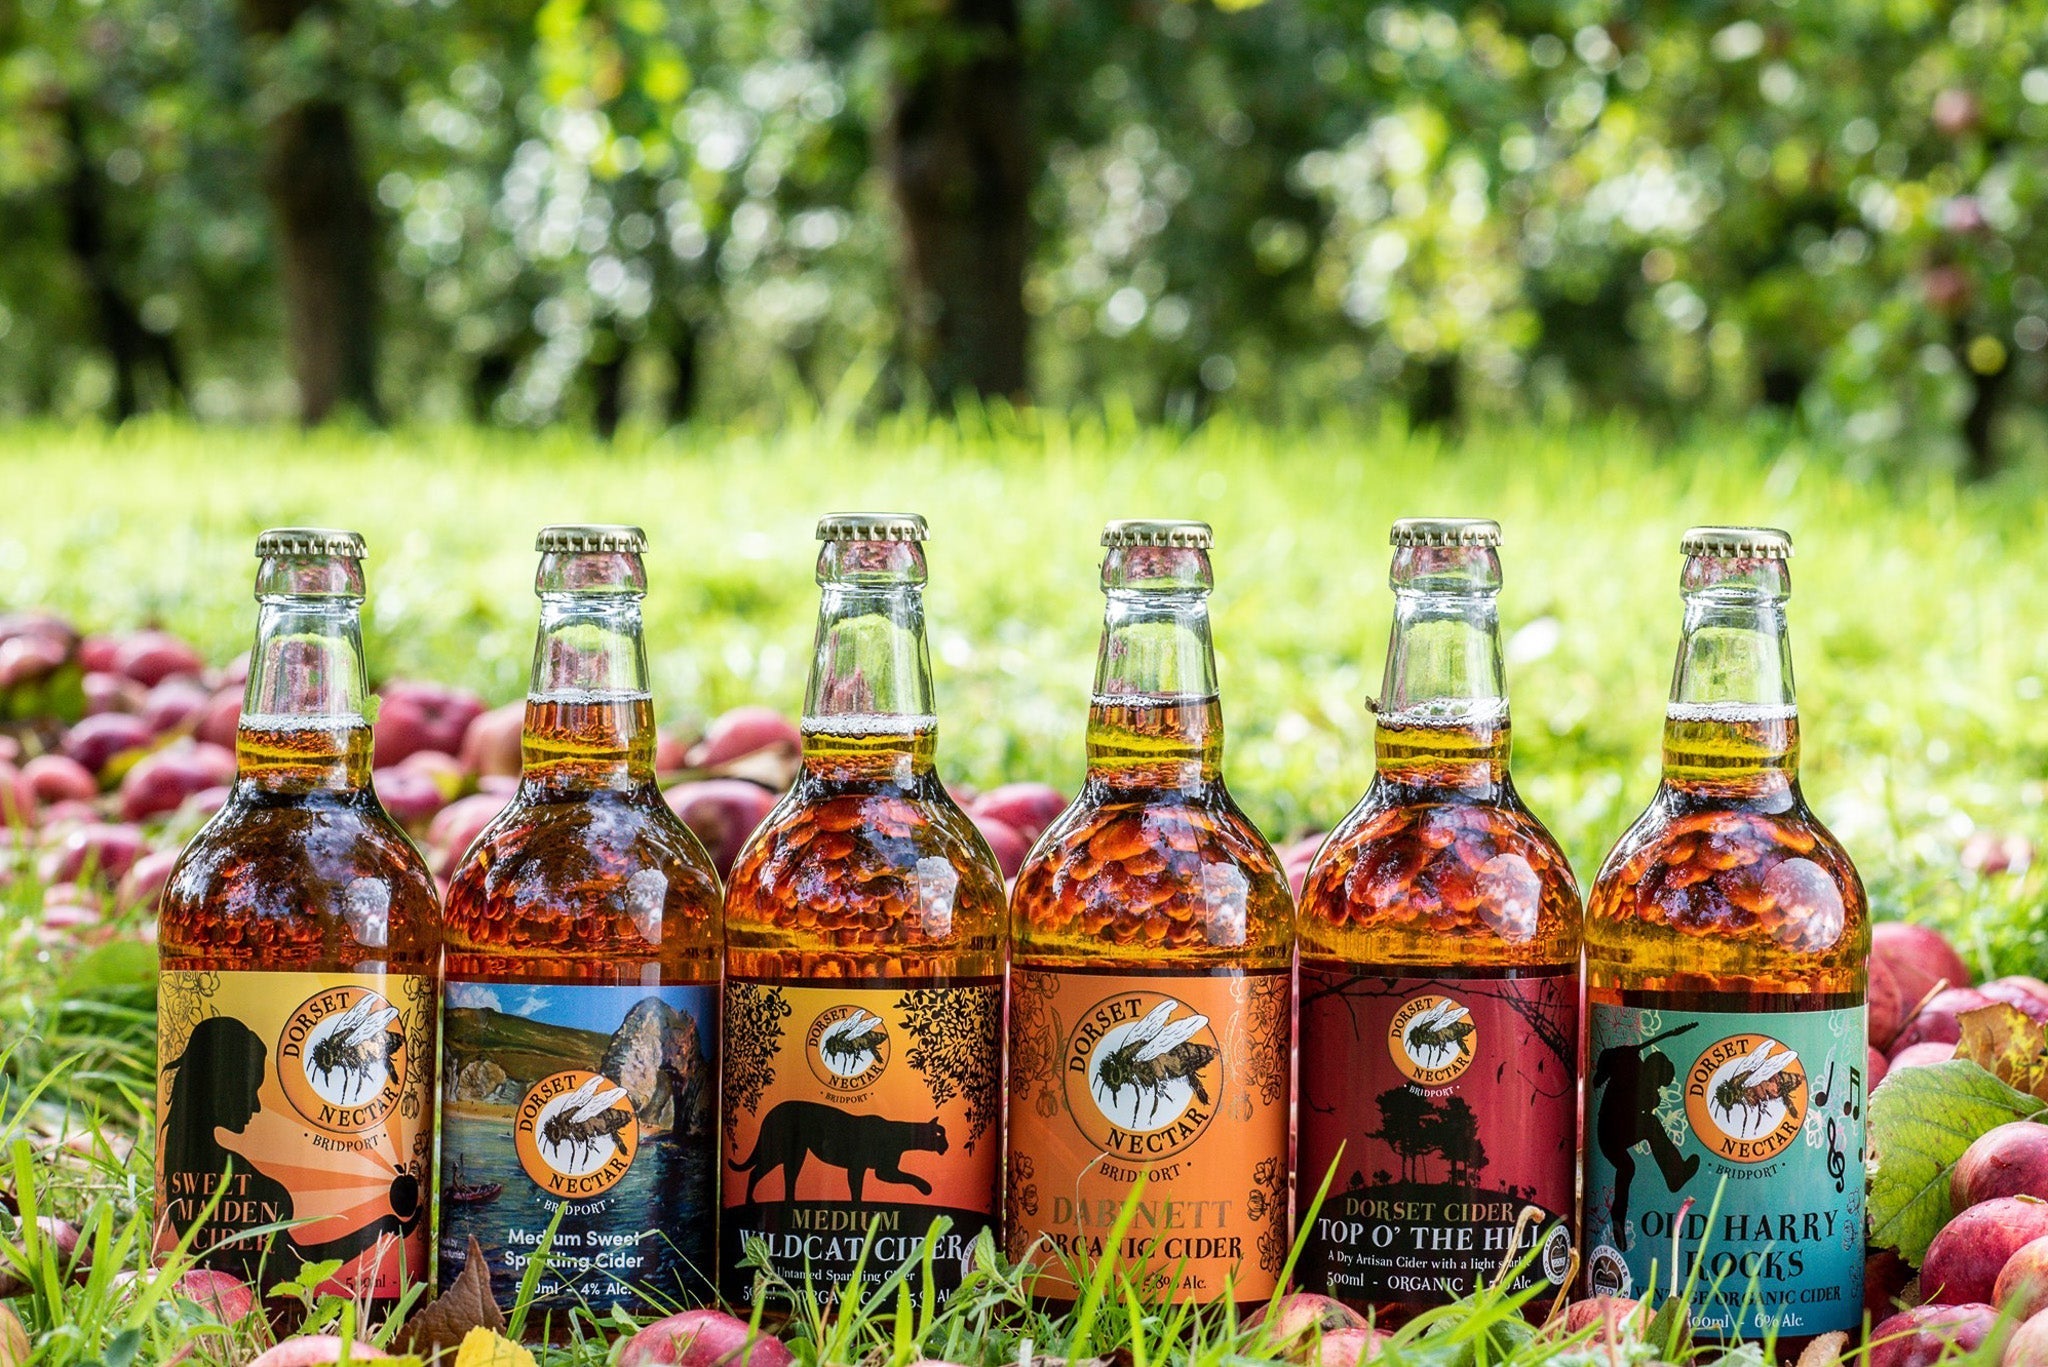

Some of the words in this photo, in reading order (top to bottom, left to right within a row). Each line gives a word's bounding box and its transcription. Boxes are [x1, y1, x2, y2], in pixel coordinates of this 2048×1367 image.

[283, 992, 350, 1059] DORSET
[808, 1008, 848, 1048] DORSET
[1392, 998, 1433, 1039] DORSET
[1069, 998, 1142, 1074] DORSET
[828, 1063, 884, 1089] NECTAR
[1413, 1056, 1469, 1082] NECTAR
[1690, 1039, 1749, 1098] DORSET
[519, 1075, 576, 1133] DORSET
[825, 1092, 868, 1104] BRIDPORT
[1409, 1085, 1453, 1098] BRIDPORT
[318, 1086, 399, 1127] NECTAR
[312, 1133, 379, 1152] BRIDPORT
[1105, 1107, 1209, 1154] NECTAR
[1720, 1121, 1798, 1158] NECTAR
[548, 1158, 628, 1193] NECTAR
[1715, 1164, 1778, 1180] BRIDPORT
[544, 1199, 607, 1216] BRDPORT
[791, 1209, 901, 1232] MEDIUM
[1052, 1196, 1233, 1229] DABNETT
[1346, 1198, 1436, 1222] DORSET
[1444, 1203, 1516, 1223] CIDER
[508, 1228, 581, 1246] Medum
[586, 1230, 640, 1247] Sweet
[1318, 1218, 1364, 1246] TOP
[1372, 1224, 1401, 1248] O'
[1410, 1227, 1473, 1250] THE
[1641, 1210, 1708, 1240] OLD
[1723, 1209, 1838, 1243] HARRY
[739, 1229, 864, 1261] WLDCAT
[1164, 1236, 1244, 1260] CIDER
[504, 1250, 590, 1272] Spkling
[595, 1252, 644, 1269] Cider
[1328, 1250, 1335, 1261] A
[1337, 1250, 1353, 1266] Dry
[1356, 1253, 1393, 1267] Artisan
[1396, 1256, 1428, 1268] Cider
[1431, 1258, 1457, 1270] with
[1460, 1261, 1467, 1270] a
[1471, 1257, 1495, 1273] light
[1685, 1248, 1804, 1282] ROCKS
[581, 1282, 600, 1295] 4%
[605, 1282, 632, 1295] Alc.
[1182, 1274, 1207, 1289] Alc.
[1327, 1272, 1364, 1287] 500ml
[1387, 1275, 1464, 1292] ORGANIC
[1715, 1289, 1797, 1307] ORGANIC
[1801, 1285, 1842, 1303] CIDER
[1690, 1313, 1729, 1328] 00ml
[1754, 1313, 1780, 1328] 6%
[1782, 1313, 1804, 1328] Alc.
